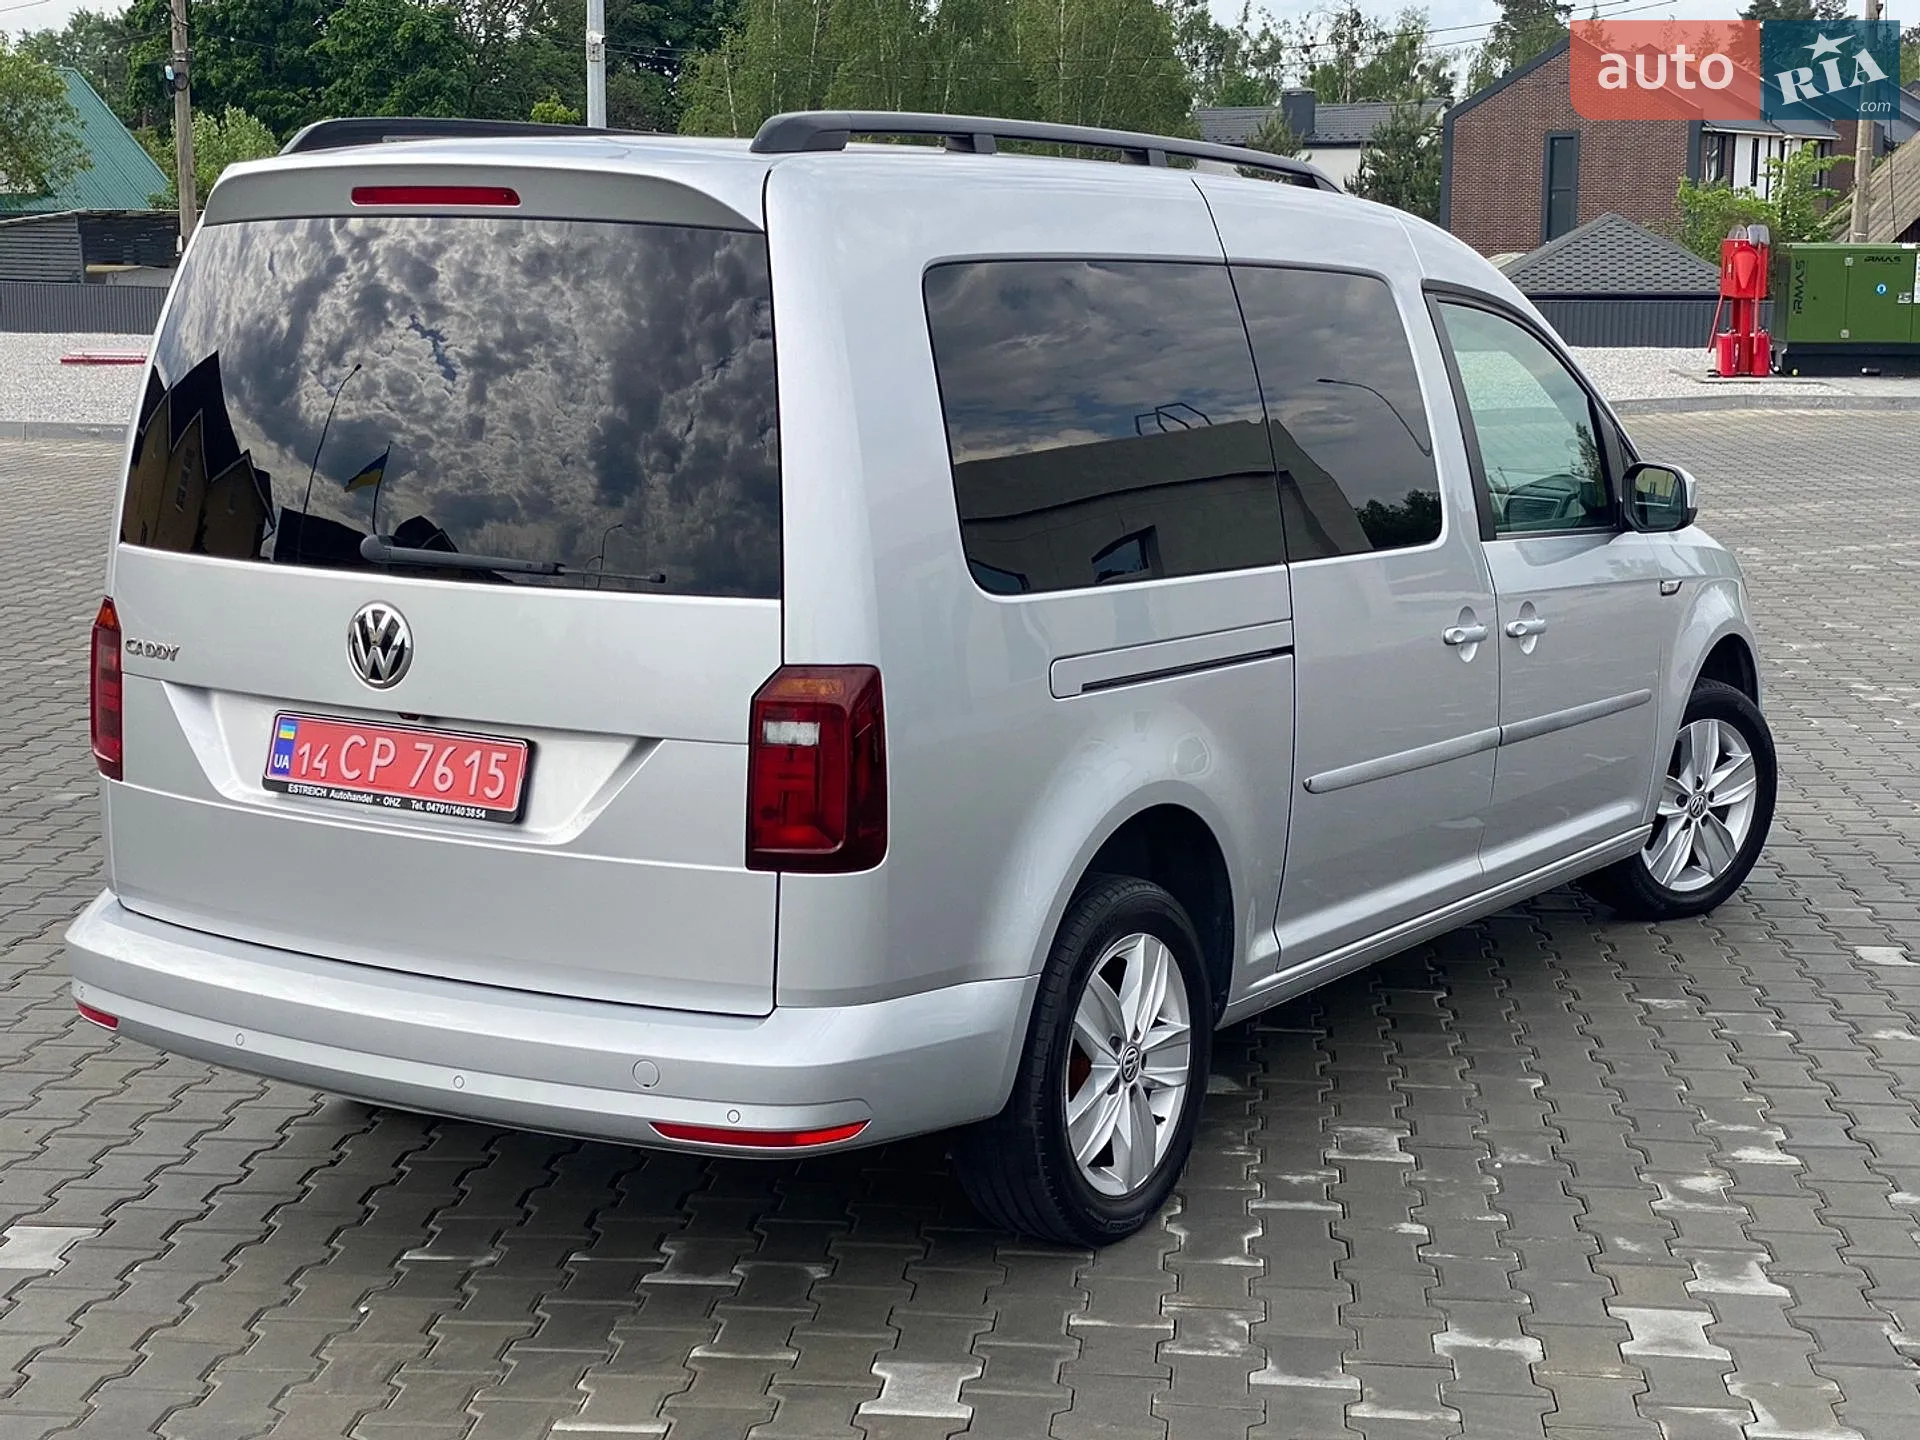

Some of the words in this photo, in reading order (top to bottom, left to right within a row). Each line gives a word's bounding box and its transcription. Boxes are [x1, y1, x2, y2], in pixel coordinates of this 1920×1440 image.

[125, 637, 181, 662] CADDY
[274, 753, 290, 770] UA
[297, 742, 330, 778] 14
[339, 734, 396, 783] CP
[409, 742, 509, 800] 7615
[329, 789, 374, 804] Autohandel
[410, 800, 424, 811] Tel.
